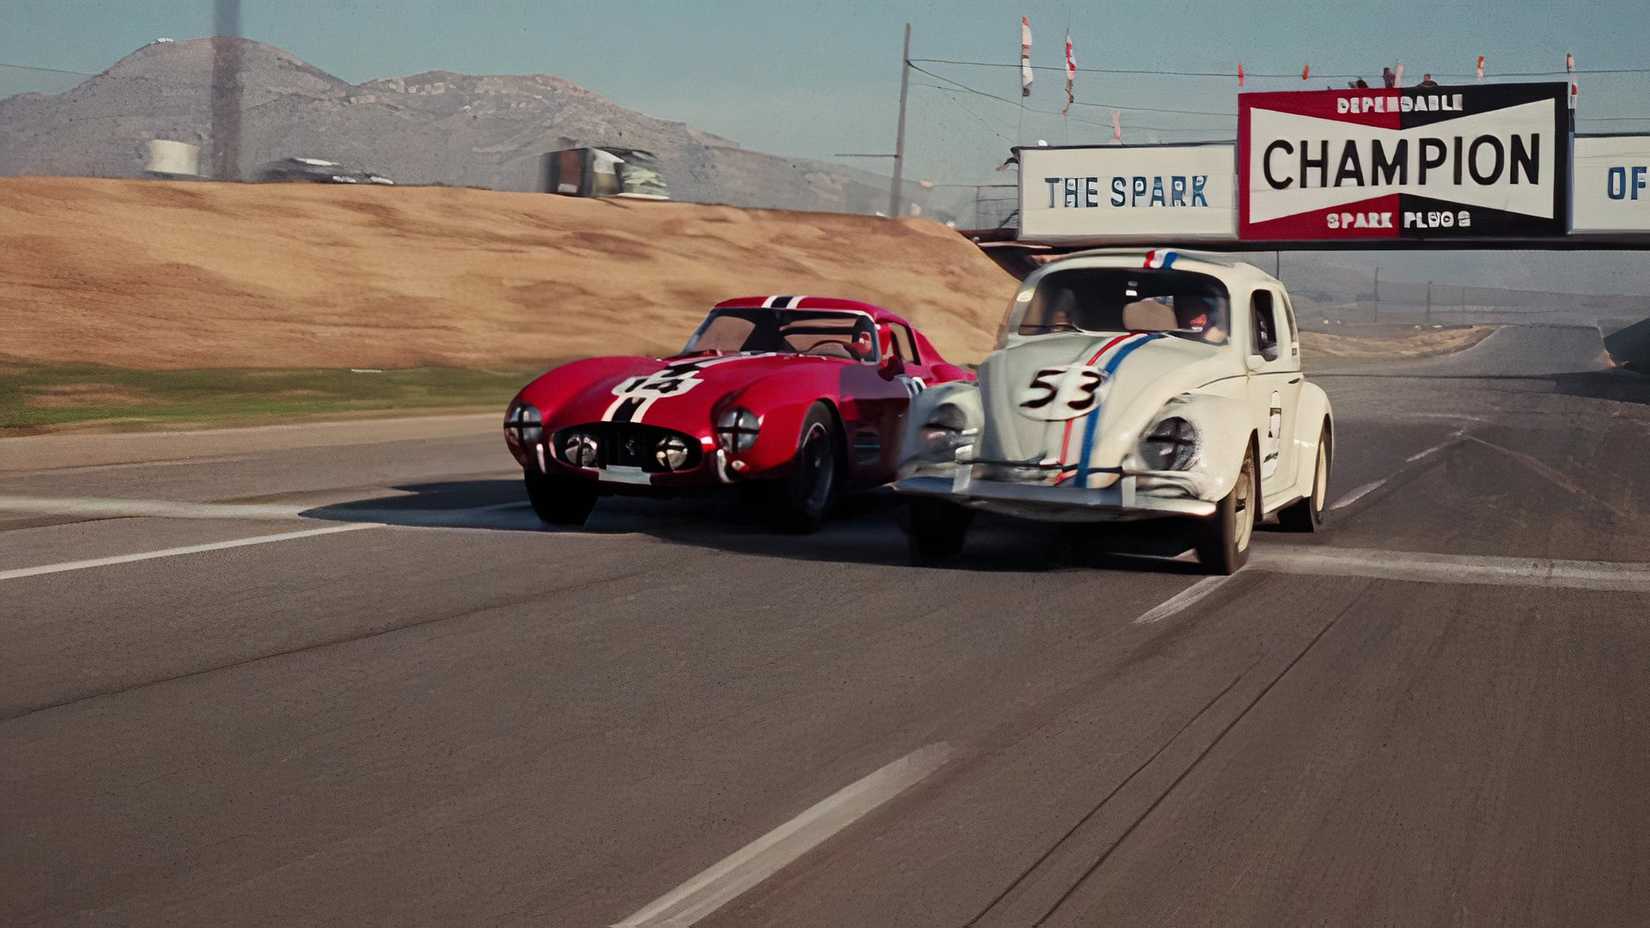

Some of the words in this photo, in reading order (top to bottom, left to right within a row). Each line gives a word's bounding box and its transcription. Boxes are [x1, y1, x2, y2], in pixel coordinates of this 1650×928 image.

[1263, 133, 1540, 189] CHAMPION
[1045, 177, 1098, 208] THE
[1111, 176, 1209, 208] SPARK
[1607, 166, 1648, 200] OF
[1327, 211, 1393, 230] SPARK
[625, 378, 684, 394] 14
[1019, 369, 1101, 410] 53
